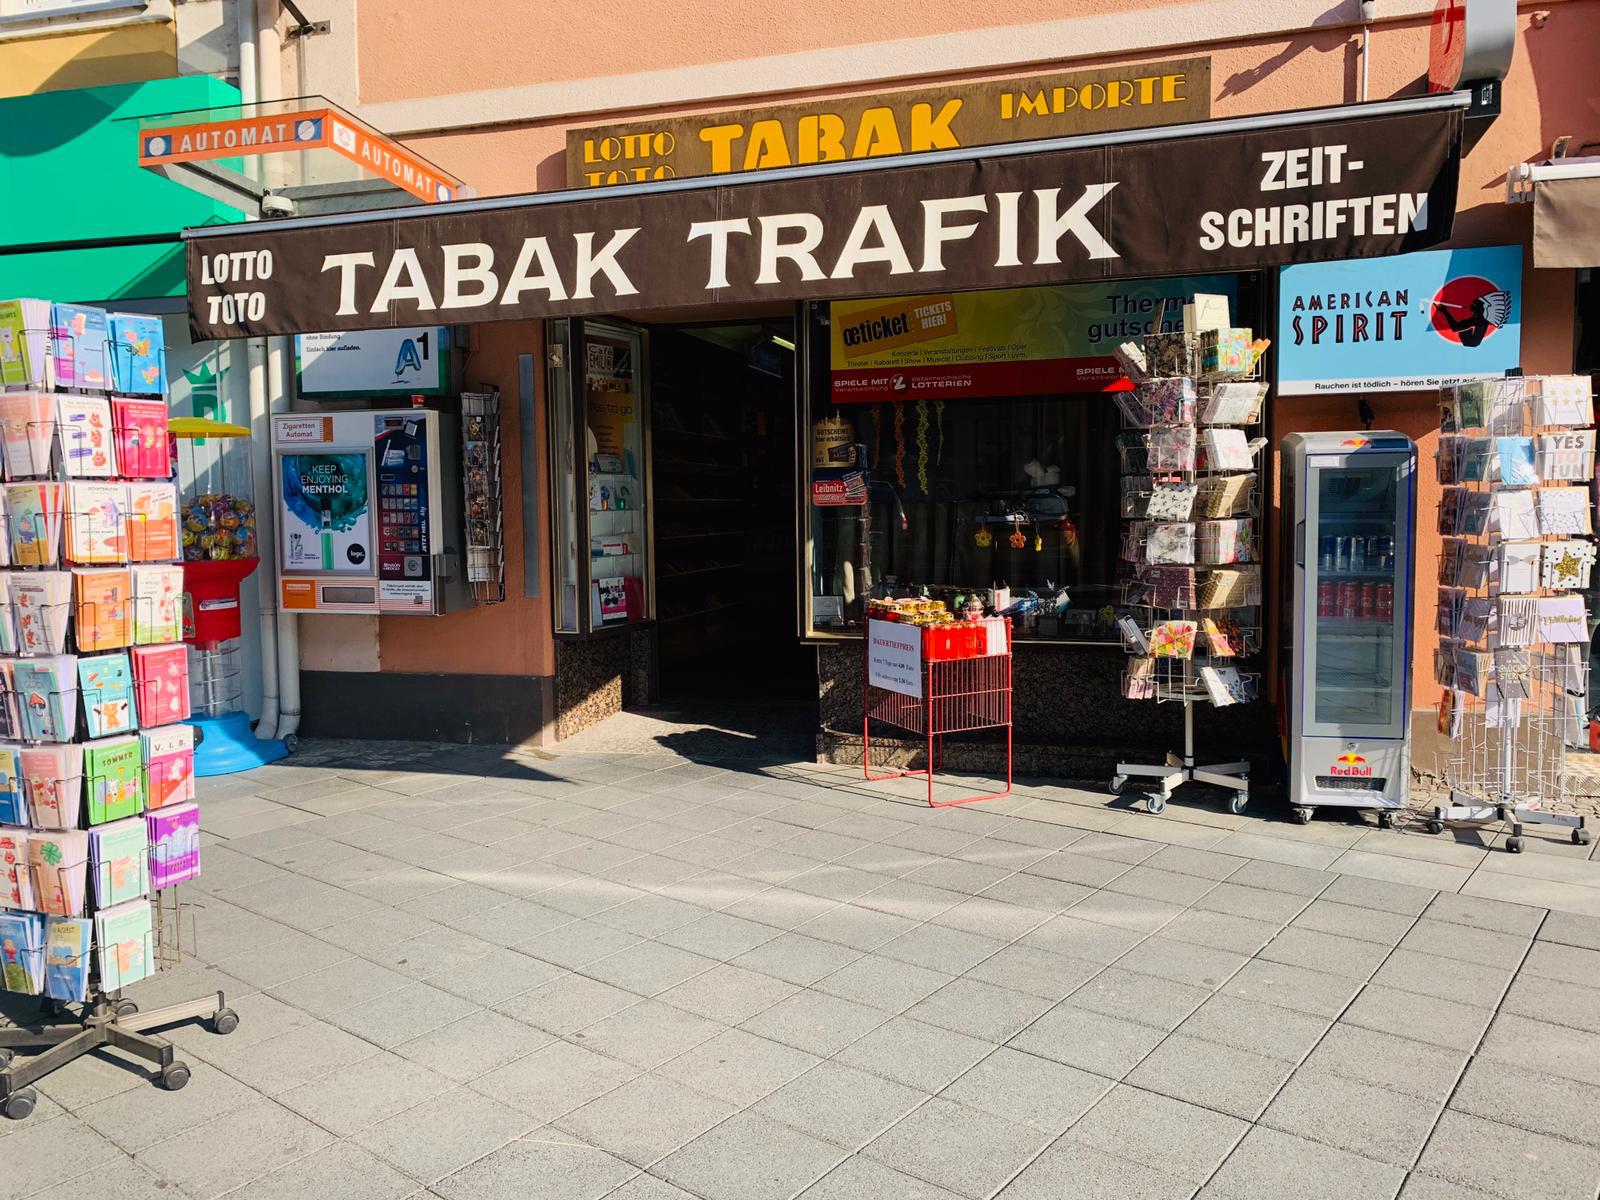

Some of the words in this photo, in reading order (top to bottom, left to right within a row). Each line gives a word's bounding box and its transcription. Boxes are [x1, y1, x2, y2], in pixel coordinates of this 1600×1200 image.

[1000, 74, 1186, 120] IMPORTE
[180, 124, 287, 153] AUTOMAT
[699, 98, 963, 173] TABAK
[583, 131, 675, 163] LOTTO
[362, 139, 433, 195] AUTOMAT
[1260, 144, 1364, 192] ZEIT-
[1199, 192, 1428, 251] SCHRIFTEN
[321, 227, 642, 316] TABAK
[687, 181, 1121, 289] TRAFIK
[201, 249, 273, 285] LOTTO
[207, 292, 266, 325] TOTO
[1292, 288, 1409, 312] AMERICAN
[914, 301, 952, 319] TICKETS
[921, 315, 948, 330] HIER!
[1293, 311, 1408, 346] SPIRIT
[395, 332, 429, 376] A1
[1076, 367, 1115, 376] SPIELE
[834, 379, 868, 388] SPIELE
[870, 378, 889, 386] MIT
[834, 385, 889, 393] Verantwortung
[911, 380, 972, 389] LOTTERIEN
[1314, 382, 1350, 390] Rauchen
[1351, 381, 1362, 389] ist
[1364, 379, 1391, 388] tödlich
[1400, 378, 1425, 387] hören
[1426, 378, 1440, 386] Sie
[282, 422, 316, 431] Zigaretten
[1552, 435, 1585, 449] YES
[312, 464, 337, 474] KEEP
[301, 474, 348, 484] ENJOYING
[302, 484, 349, 494] MENTHOL
[815, 483, 844, 494] Leibnitz
[1330, 766, 1351, 776] Red
[1352, 767, 1372, 776] Bull
